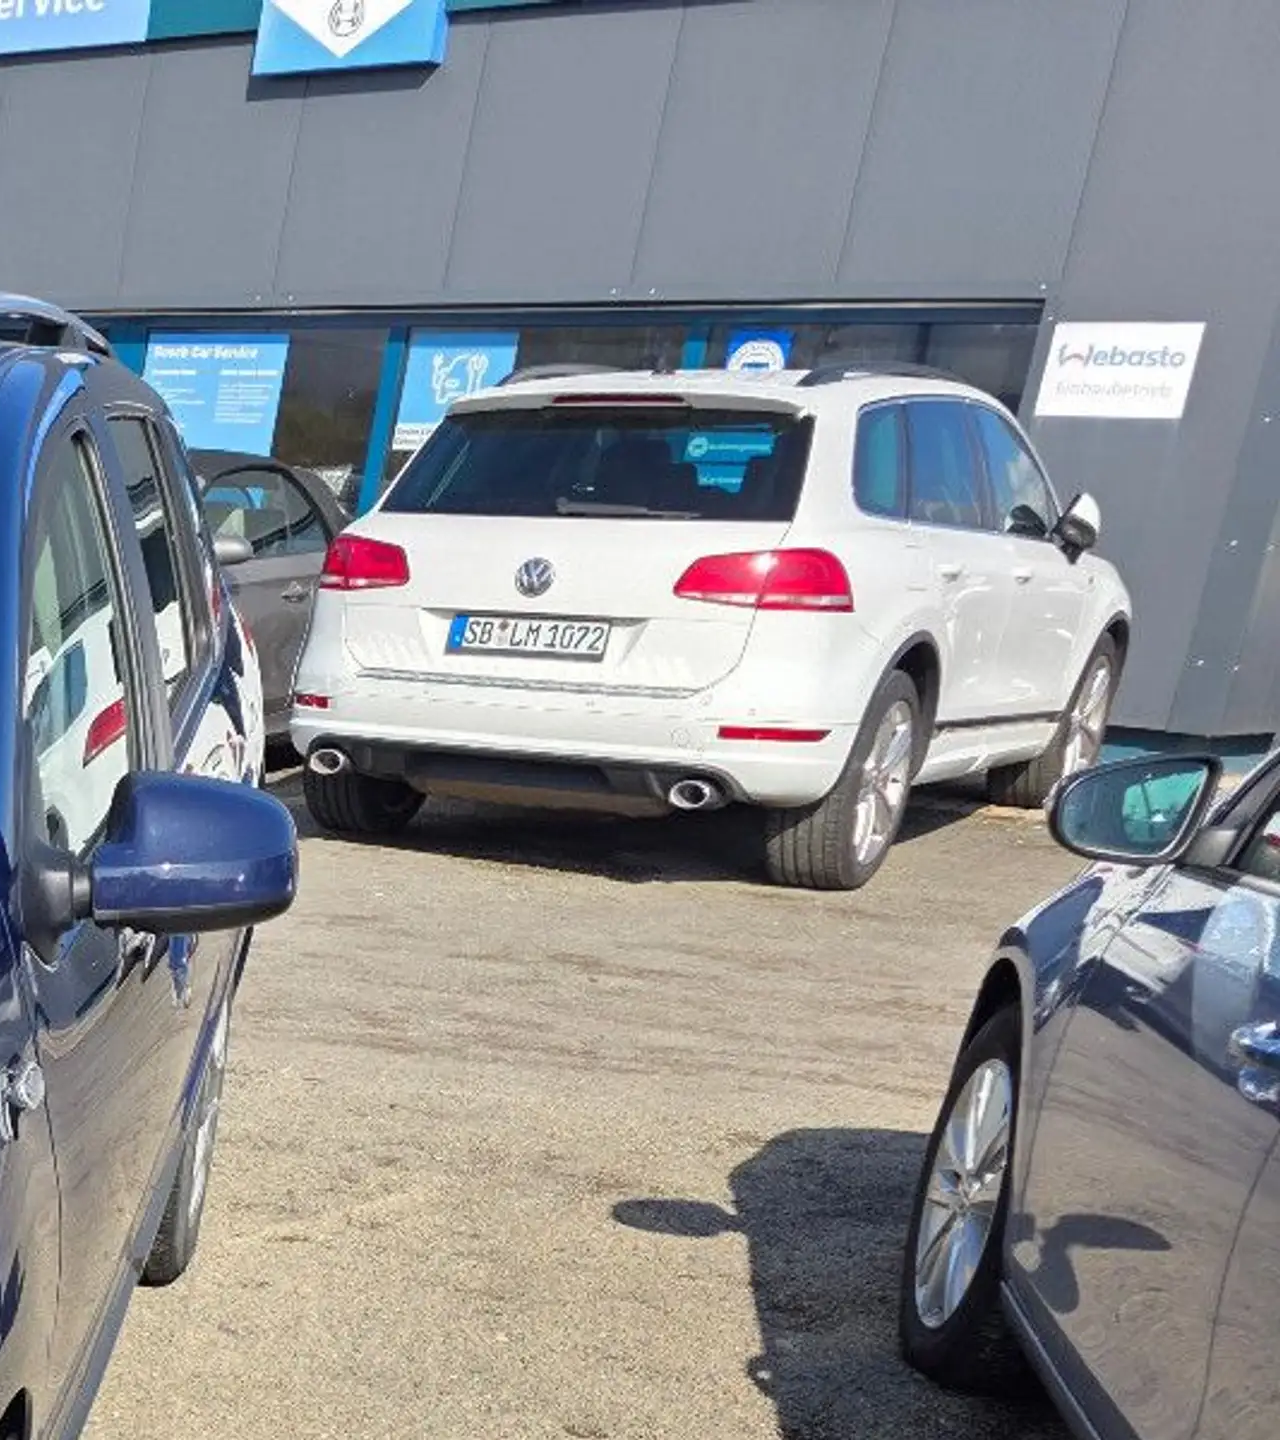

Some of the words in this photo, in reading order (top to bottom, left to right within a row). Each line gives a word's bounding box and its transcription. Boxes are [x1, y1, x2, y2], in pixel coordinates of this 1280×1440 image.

[1057, 342, 1186, 367] Webasto
[463, 619, 494, 646] SB
[508, 621, 542, 648] LM
[543, 624, 606, 652] 1072
